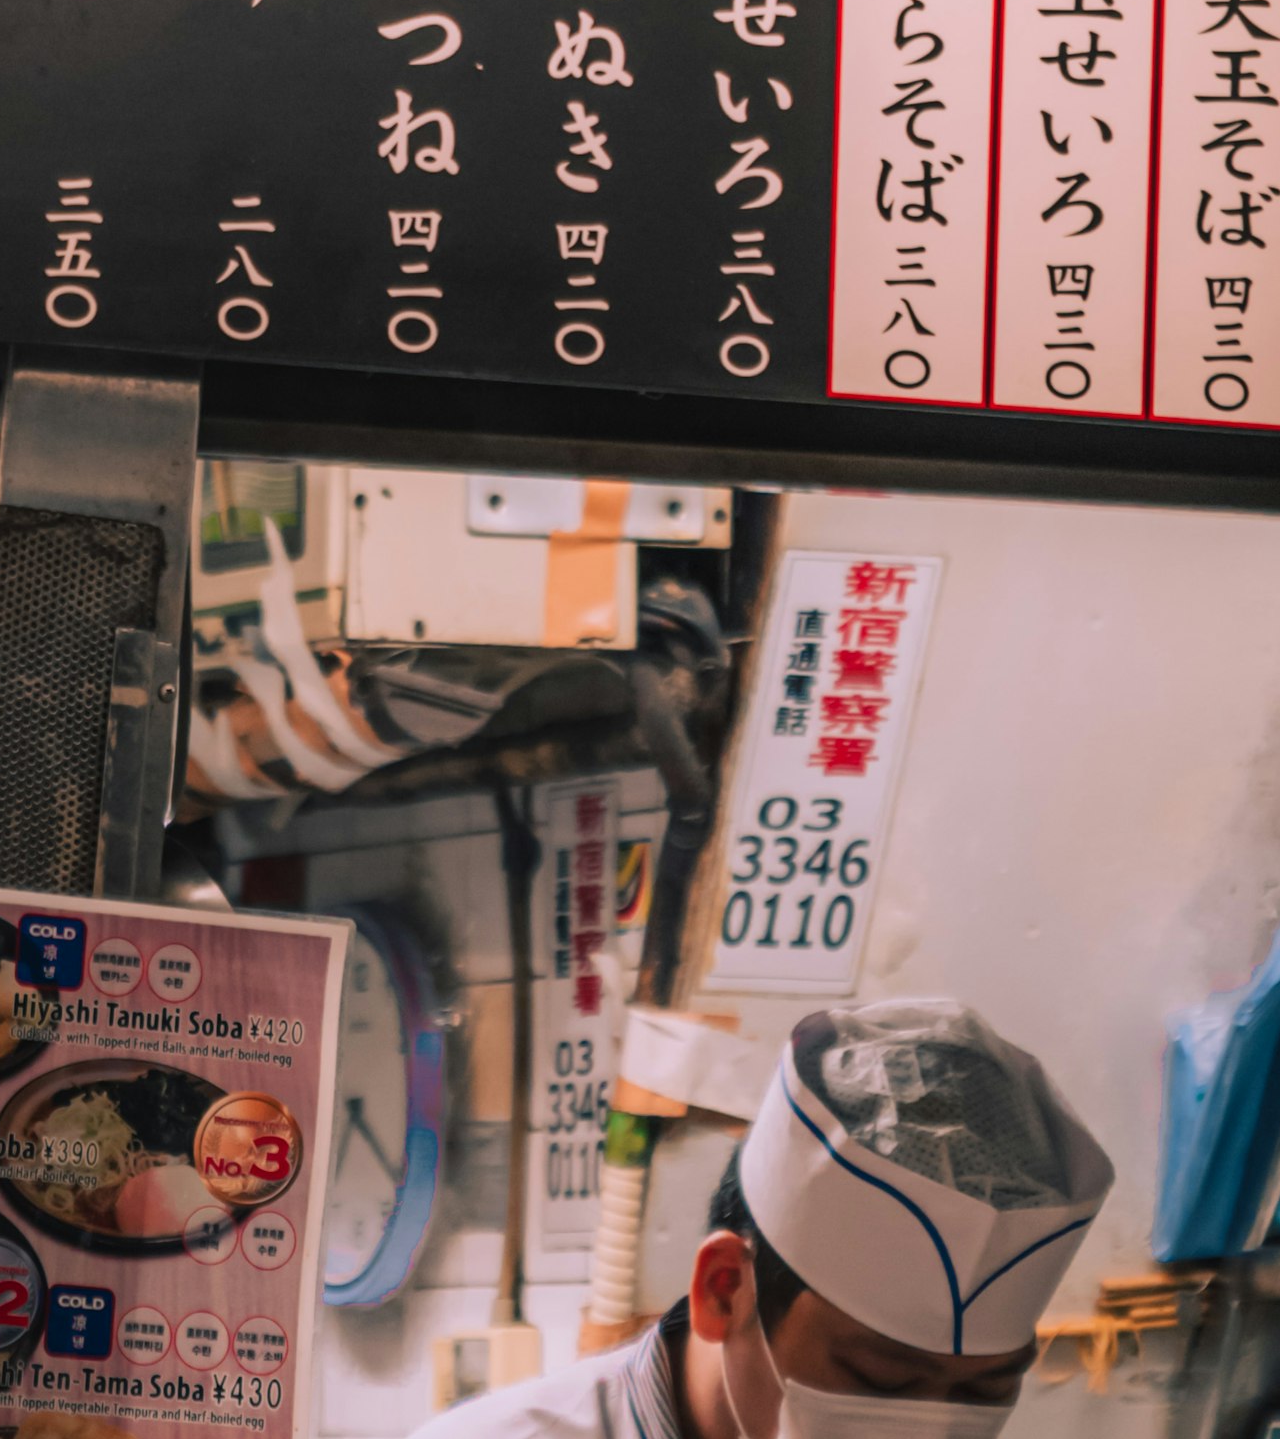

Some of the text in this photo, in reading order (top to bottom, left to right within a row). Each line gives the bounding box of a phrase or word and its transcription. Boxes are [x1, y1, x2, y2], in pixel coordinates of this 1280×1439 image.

[44, 176, 103, 329] 三五〇
[216, 195, 276, 342] 二八〇
[386, 208, 444, 353] 四二〇
[554, 221, 610, 366] 四二〇
[719, 231, 776, 378] 三八〇
[882, 245, 938, 389] 三八〇
[1043, 261, 1097, 400] 四三〇
[1202, 275, 1254, 413] 四三〇
[775, 607, 826, 737] 直通電話
[809, 561, 918, 778] 新宿警察署
[757, 796, 846, 834] 03
[731, 837, 870, 887] 3346
[29, 923, 77, 942] COLD
[722, 893, 856, 950] 0110
[13, 992, 304, 1045] Hiyashi Tanuki Soba ¥420
[11, 1026, 33, 1039] Cold
[67, 1032, 90, 1045] with
[94, 1033, 131, 1050] Topped
[134, 1037, 160, 1052] Fried
[163, 1041, 186, 1055] Balls
[189, 1045, 209, 1057] and
[211, 1045, 270, 1063] Harf-boiled
[272, 1053, 293, 1069] egg
[556, 1039, 594, 1076] 03
[547, 1082, 610, 1134] 3346
[43, 1137, 99, 1168] ¥390
[204, 1135, 292, 1181] No.3
[77, 1173, 98, 1188] egg
[57, 1293, 106, 1312] COLD
[31, 1363, 143, 1397] Ten-Tama
[149, 1374, 204, 1402] Soba
[212, 1374, 283, 1410] ¥430
[17, 1395, 56, 1413] Topped
[58, 1398, 110, 1417] Vegetable
[113, 1403, 158, 1422] Tempura
[161, 1408, 181, 1421] and
[183, 1409, 243, 1427] Harf-boiled
[245, 1416, 266, 1431] egg
